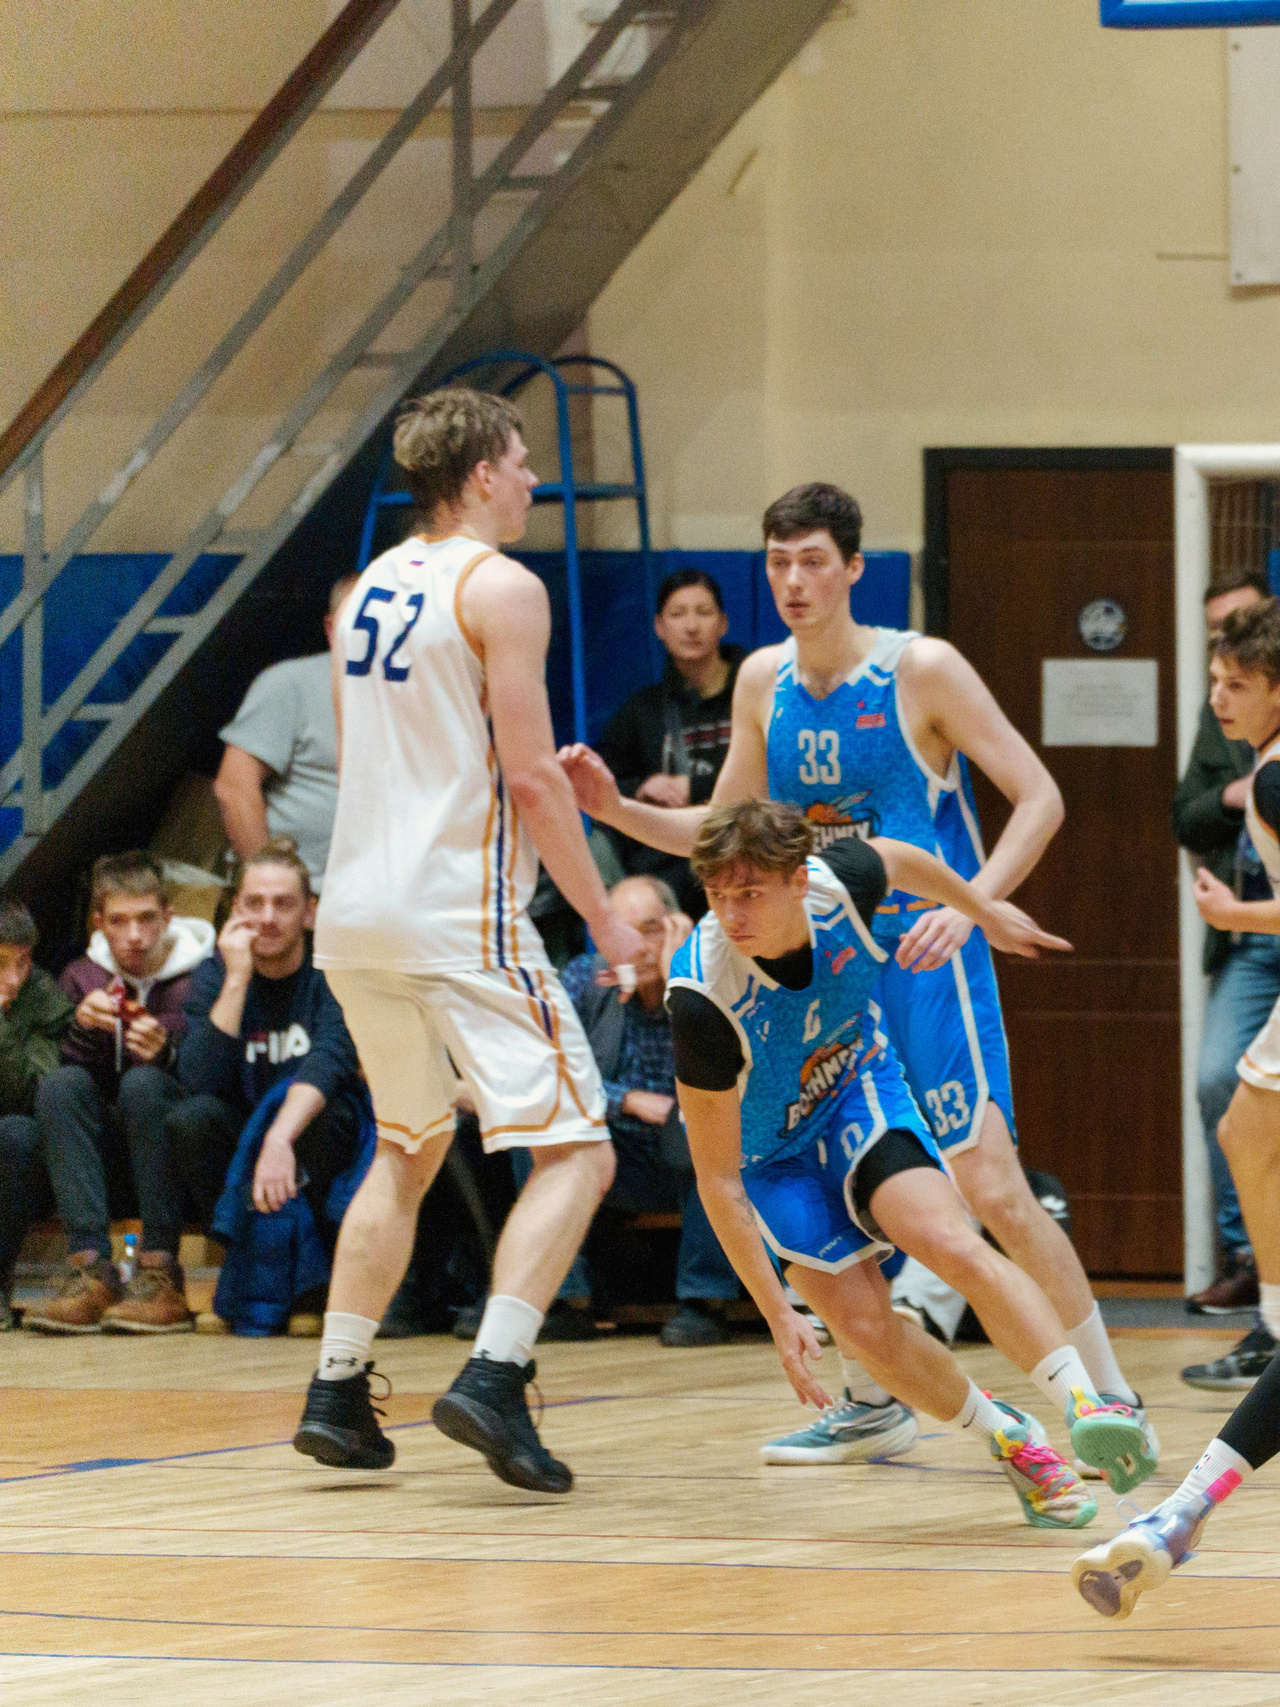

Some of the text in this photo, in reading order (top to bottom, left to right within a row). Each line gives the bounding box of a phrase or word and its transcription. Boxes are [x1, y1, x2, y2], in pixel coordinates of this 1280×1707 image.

[345, 586, 425, 682] 52
[798, 729, 841, 785] 33
[924, 1080, 970, 1137] 33
